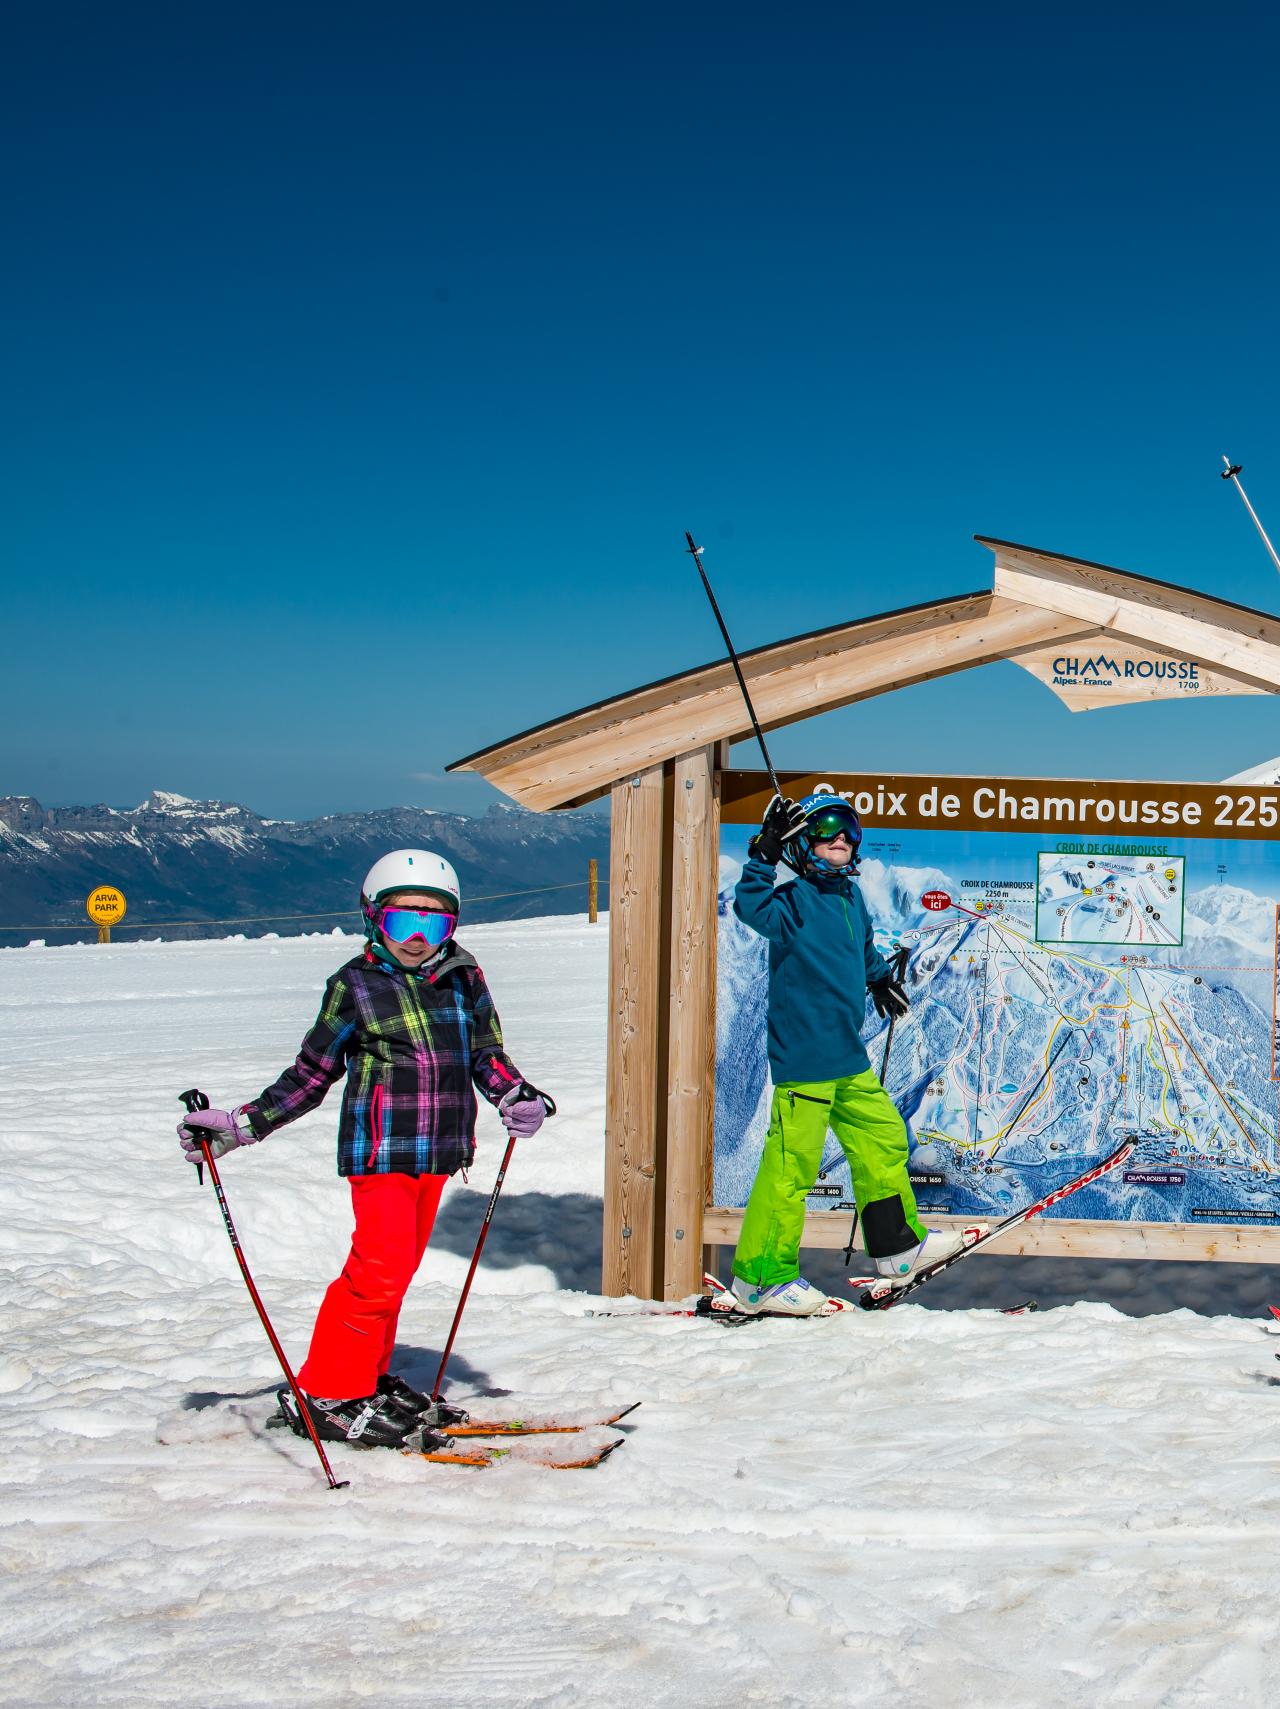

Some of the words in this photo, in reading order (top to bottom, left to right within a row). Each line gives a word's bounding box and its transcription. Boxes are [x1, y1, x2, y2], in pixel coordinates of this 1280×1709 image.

[1053, 654, 1199, 680] CHAMROUSSE
[1053, 677, 1077, 686] Alpes
[1084, 677, 1112, 686] France
[1178, 681, 1199, 689] 1700
[918, 786, 961, 818] de
[973, 787, 1202, 825] Chamrousse
[1056, 842, 1085, 853] CROIX
[1088, 843, 1100, 854] DE
[1102, 844, 1168, 855] CHAMROUSSE
[961, 880, 979, 888] CROIX
[990, 881, 1034, 889] CHAMROUSSE
[985, 890, 1001, 898] 2250
[930, 899, 942, 909] ici
[1127, 1174, 1167, 1182] CHAMROUSSE
